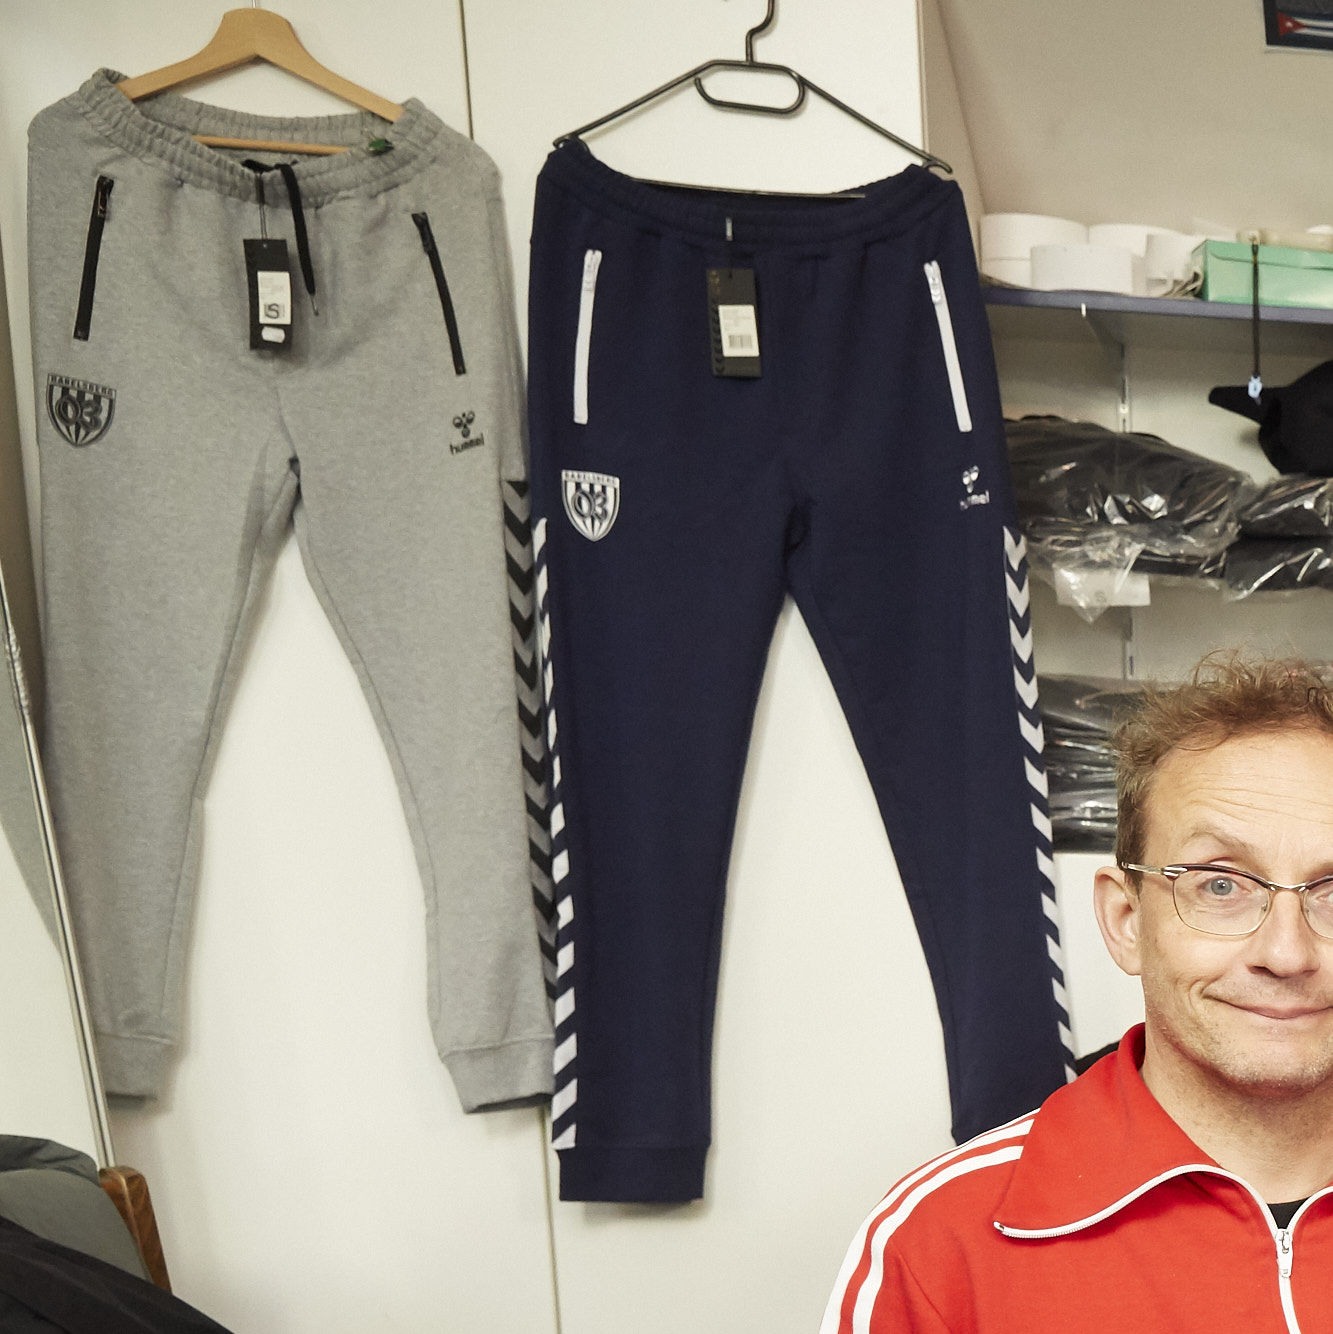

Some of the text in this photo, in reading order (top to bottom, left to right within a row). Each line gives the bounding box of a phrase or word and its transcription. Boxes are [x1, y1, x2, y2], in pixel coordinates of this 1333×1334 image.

[264, 303, 280, 320] S
[55, 395, 103, 432] 03
[571, 489, 609, 522] 03
